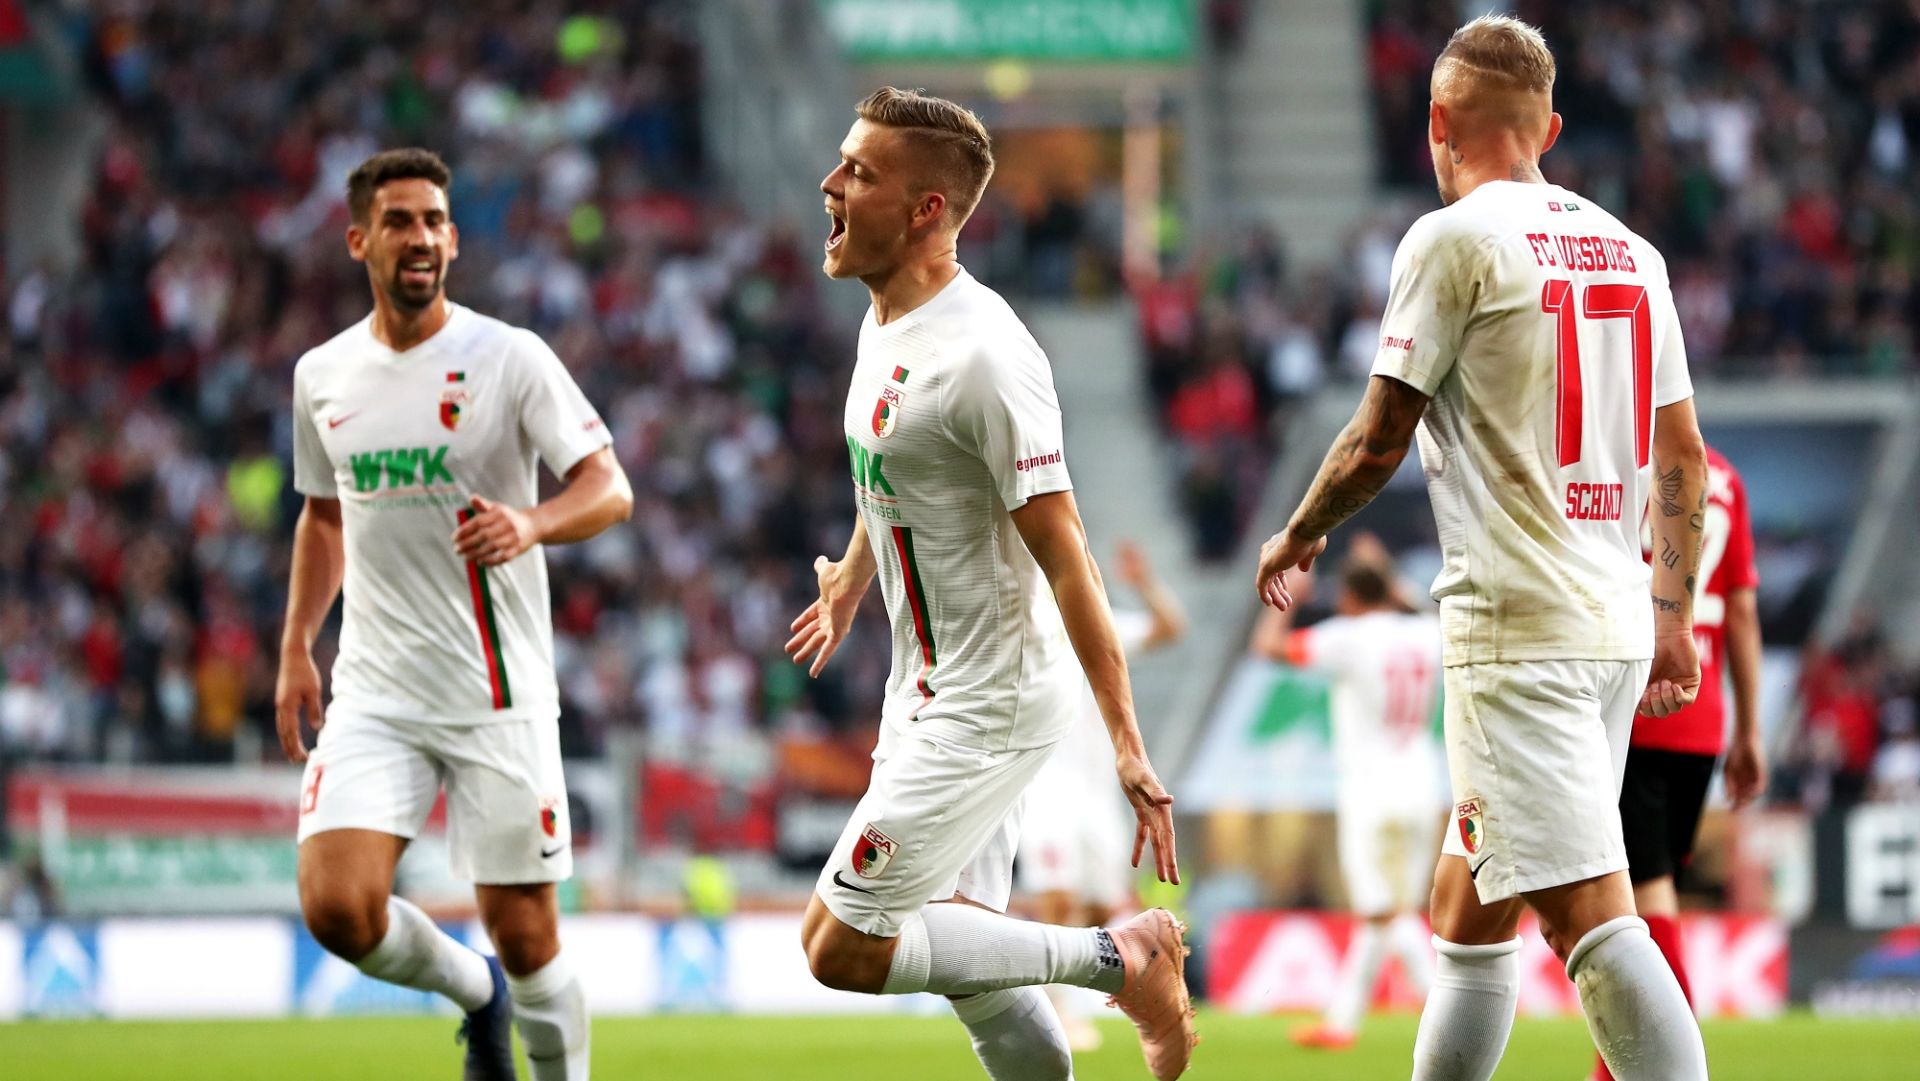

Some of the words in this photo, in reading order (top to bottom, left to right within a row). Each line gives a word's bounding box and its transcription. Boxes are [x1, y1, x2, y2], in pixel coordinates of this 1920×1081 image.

[1526, 233, 1557, 267] FC
[1554, 235, 1637, 273] UGSBURG
[1541, 278, 1652, 470] 17
[882, 388, 899, 405] FCA
[351, 445, 455, 493] WWK
[1457, 802, 1478, 817] FCA
[866, 828, 891, 854] FCA
